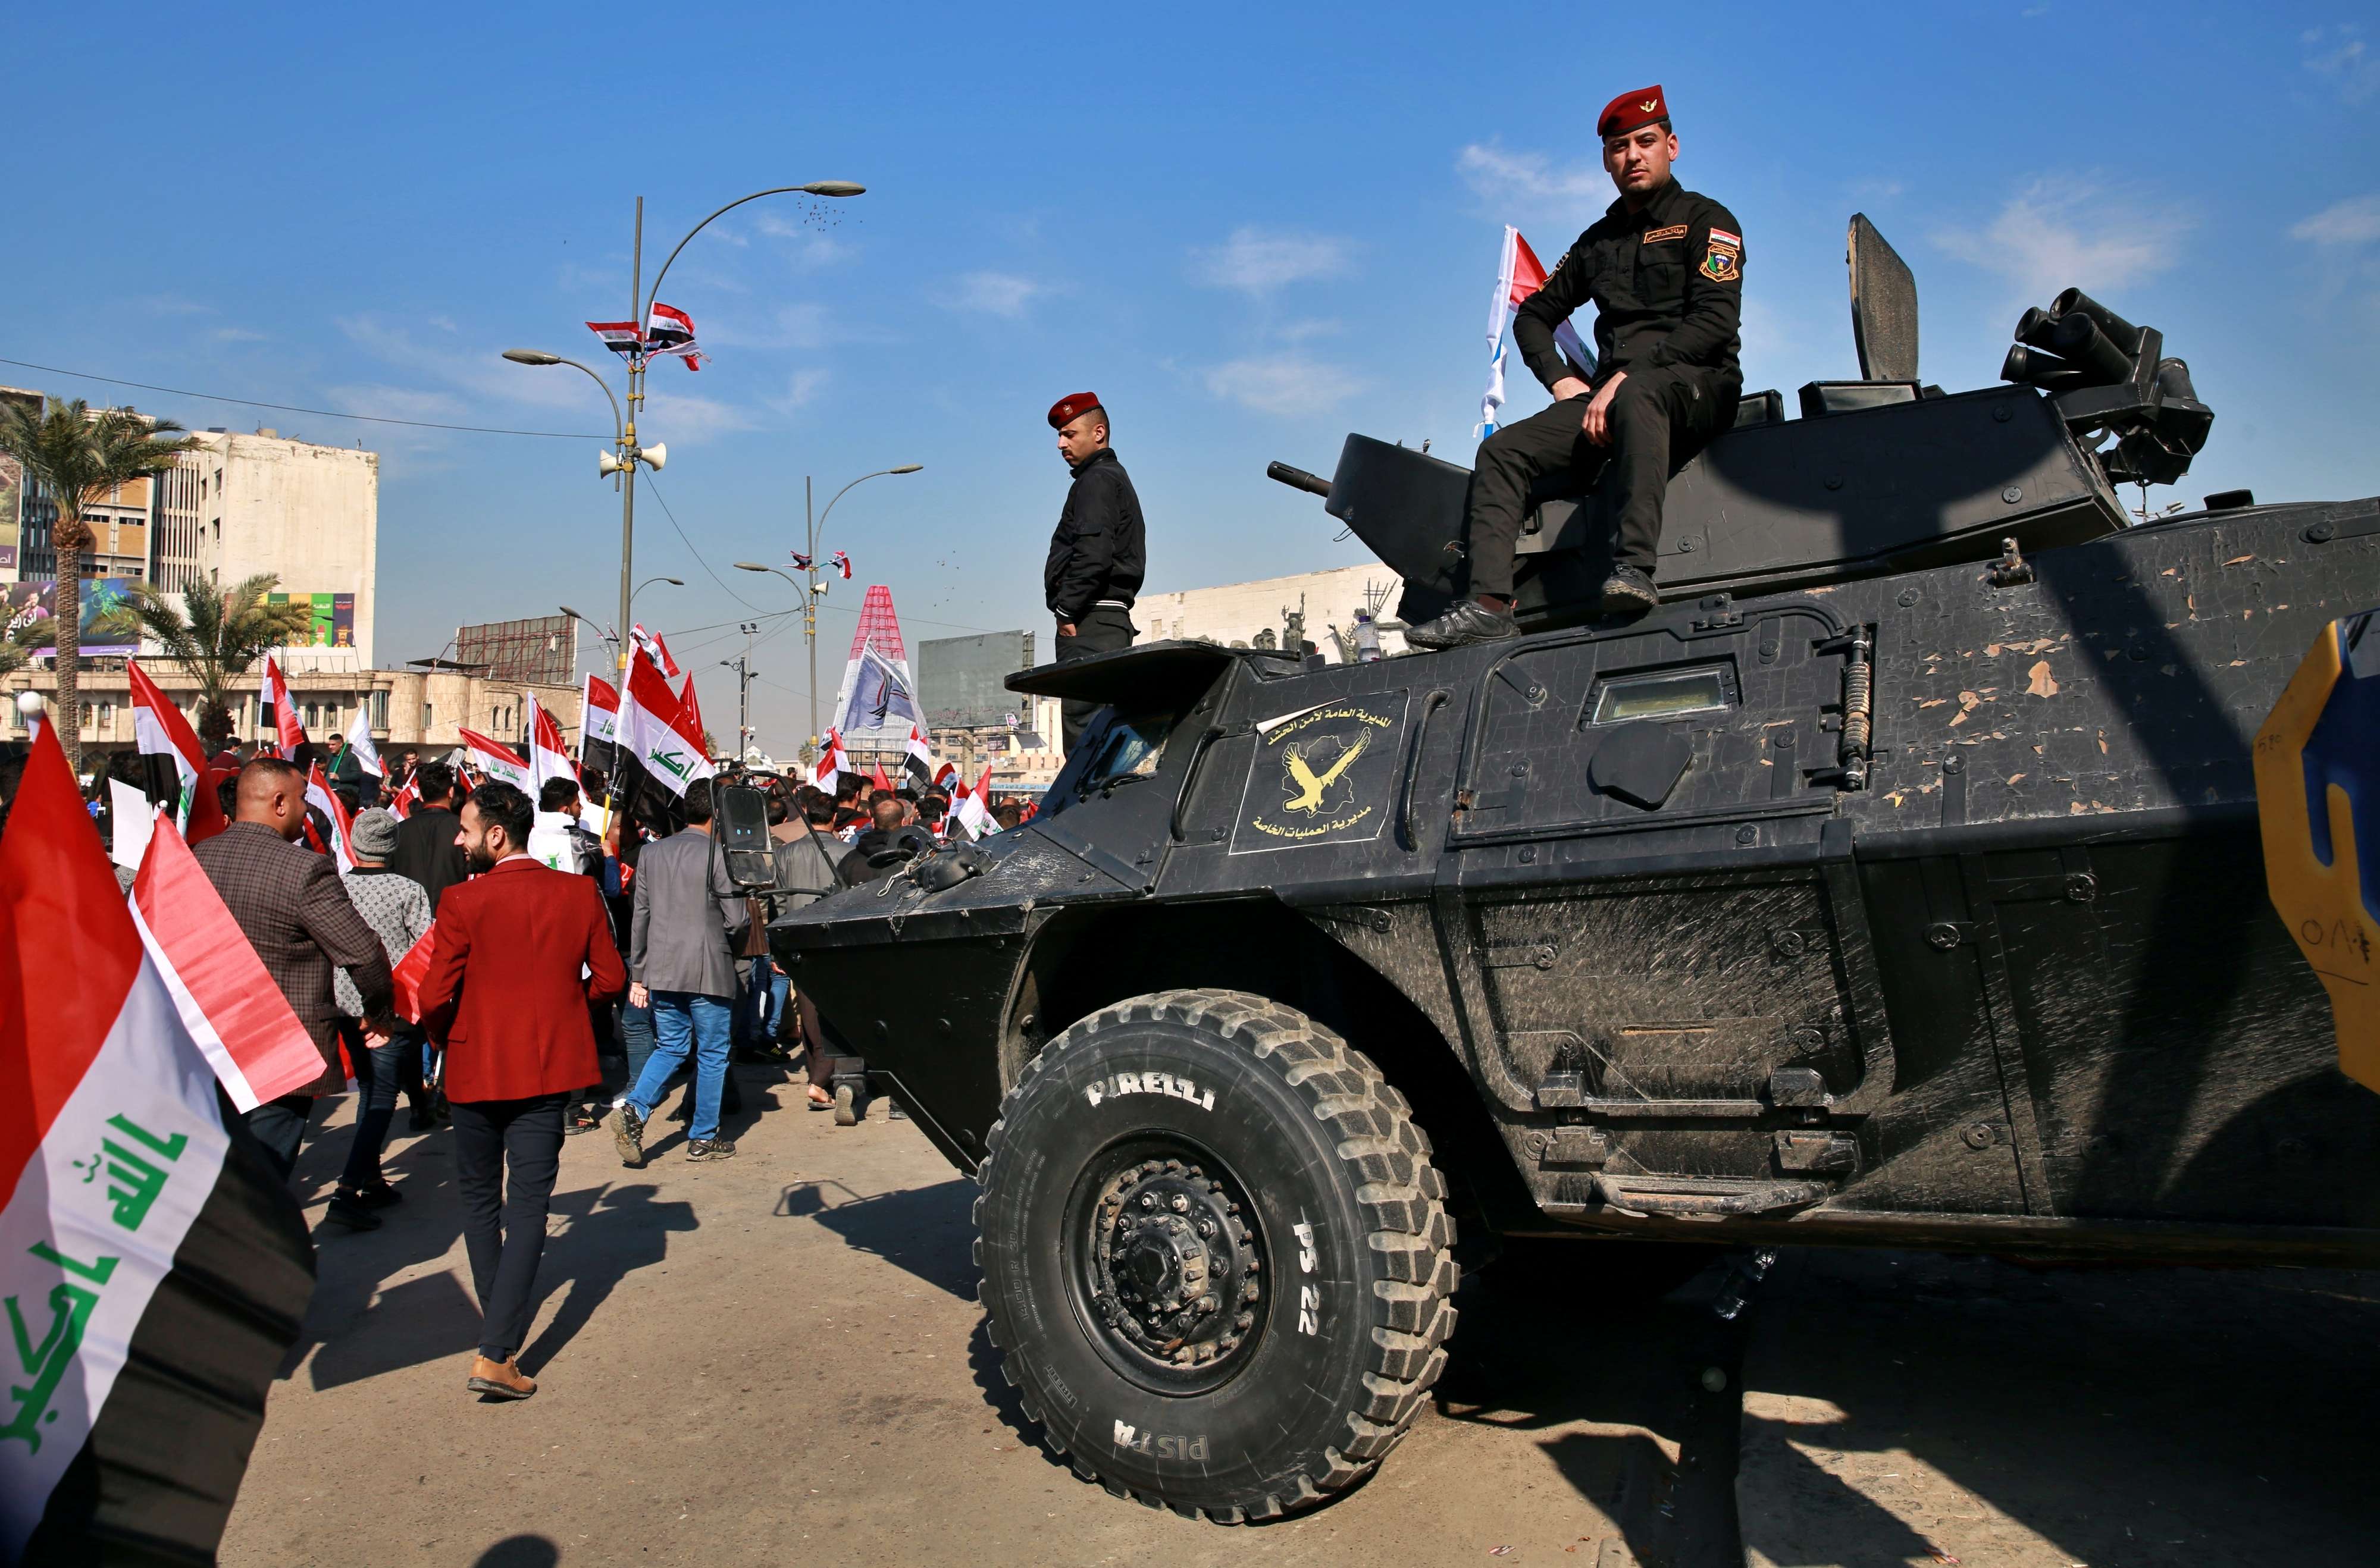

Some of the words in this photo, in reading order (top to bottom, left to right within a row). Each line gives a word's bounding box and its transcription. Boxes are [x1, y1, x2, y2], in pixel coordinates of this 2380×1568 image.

[1324, 708, 1356, 718] العامة
[1356, 708, 1392, 728] المديرية
[1267, 720, 1298, 746] الحشد
[1252, 816, 1285, 836] الخاصة
[1332, 805, 1372, 830] مديرية
[1285, 823, 1330, 840] العمليات
[1085, 1070, 1217, 1113] PIRELLI
[73, 1112, 189, 1232] الله
[1009, 1230, 1019, 1253] 20
[1293, 1222, 1321, 1274] PS
[1009, 1260, 1020, 1272] R
[1297, 1284, 1321, 1337] 22
[0, 1241, 121, 1456] اكبر
[1113, 1419, 1210, 1462] PISTA
